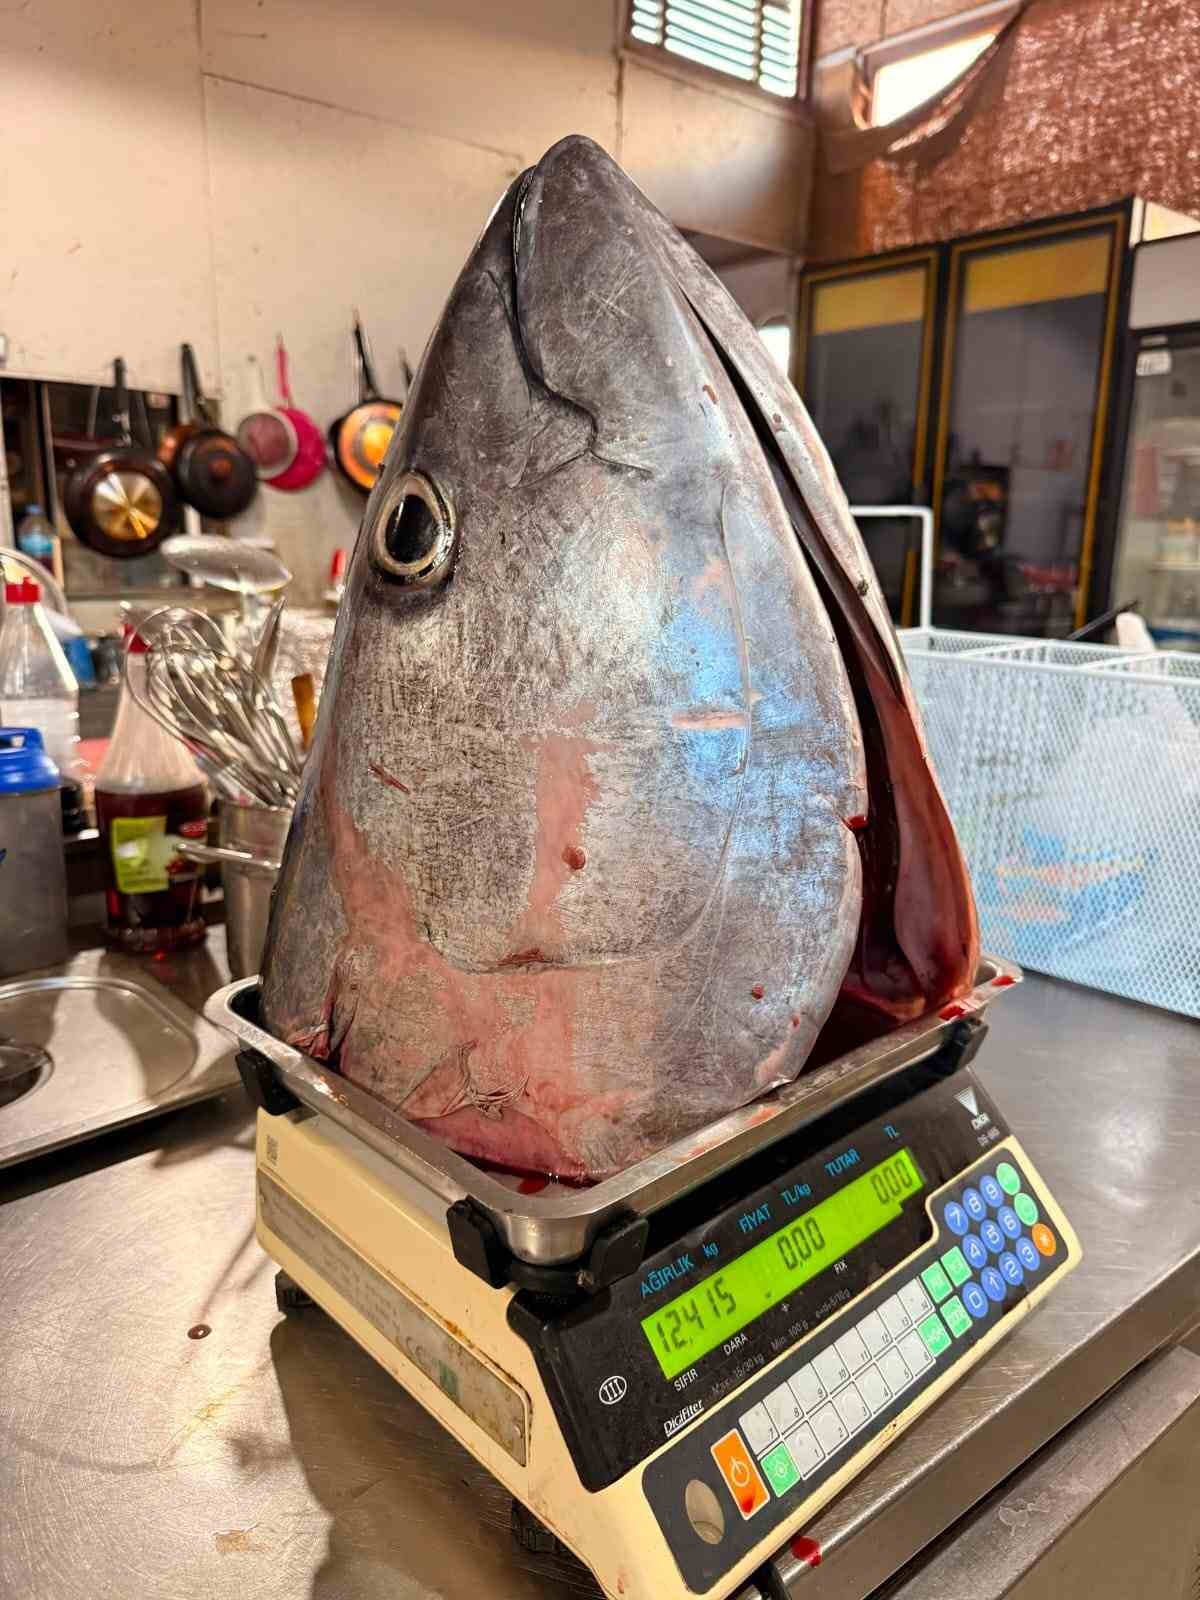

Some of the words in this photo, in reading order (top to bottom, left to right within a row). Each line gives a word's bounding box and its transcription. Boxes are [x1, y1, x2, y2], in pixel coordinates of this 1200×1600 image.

[640, 1254, 695, 1298] AĞIRLIK
[703, 1241, 719, 1257] kg
[738, 1202, 771, 1233] FİYAT
[781, 1182, 812, 1206] TL/kg
[824, 1148, 860, 1177] TUTAR
[883, 1124, 900, 1140] TL
[969, 1193, 982, 1213] 8
[986, 1183, 999, 1200] 9
[969, 1243, 982, 1260] 4
[986, 1225, 1000, 1244] 5
[1003, 1214, 1016, 1232] 6
[968, 1290, 983, 1309] 0
[1004, 1260, 1018, 1279] 2
[1021, 1245, 1034, 1263] 3
[674, 1368, 699, 1392] SIFIR
[723, 1333, 748, 1356] DARA
